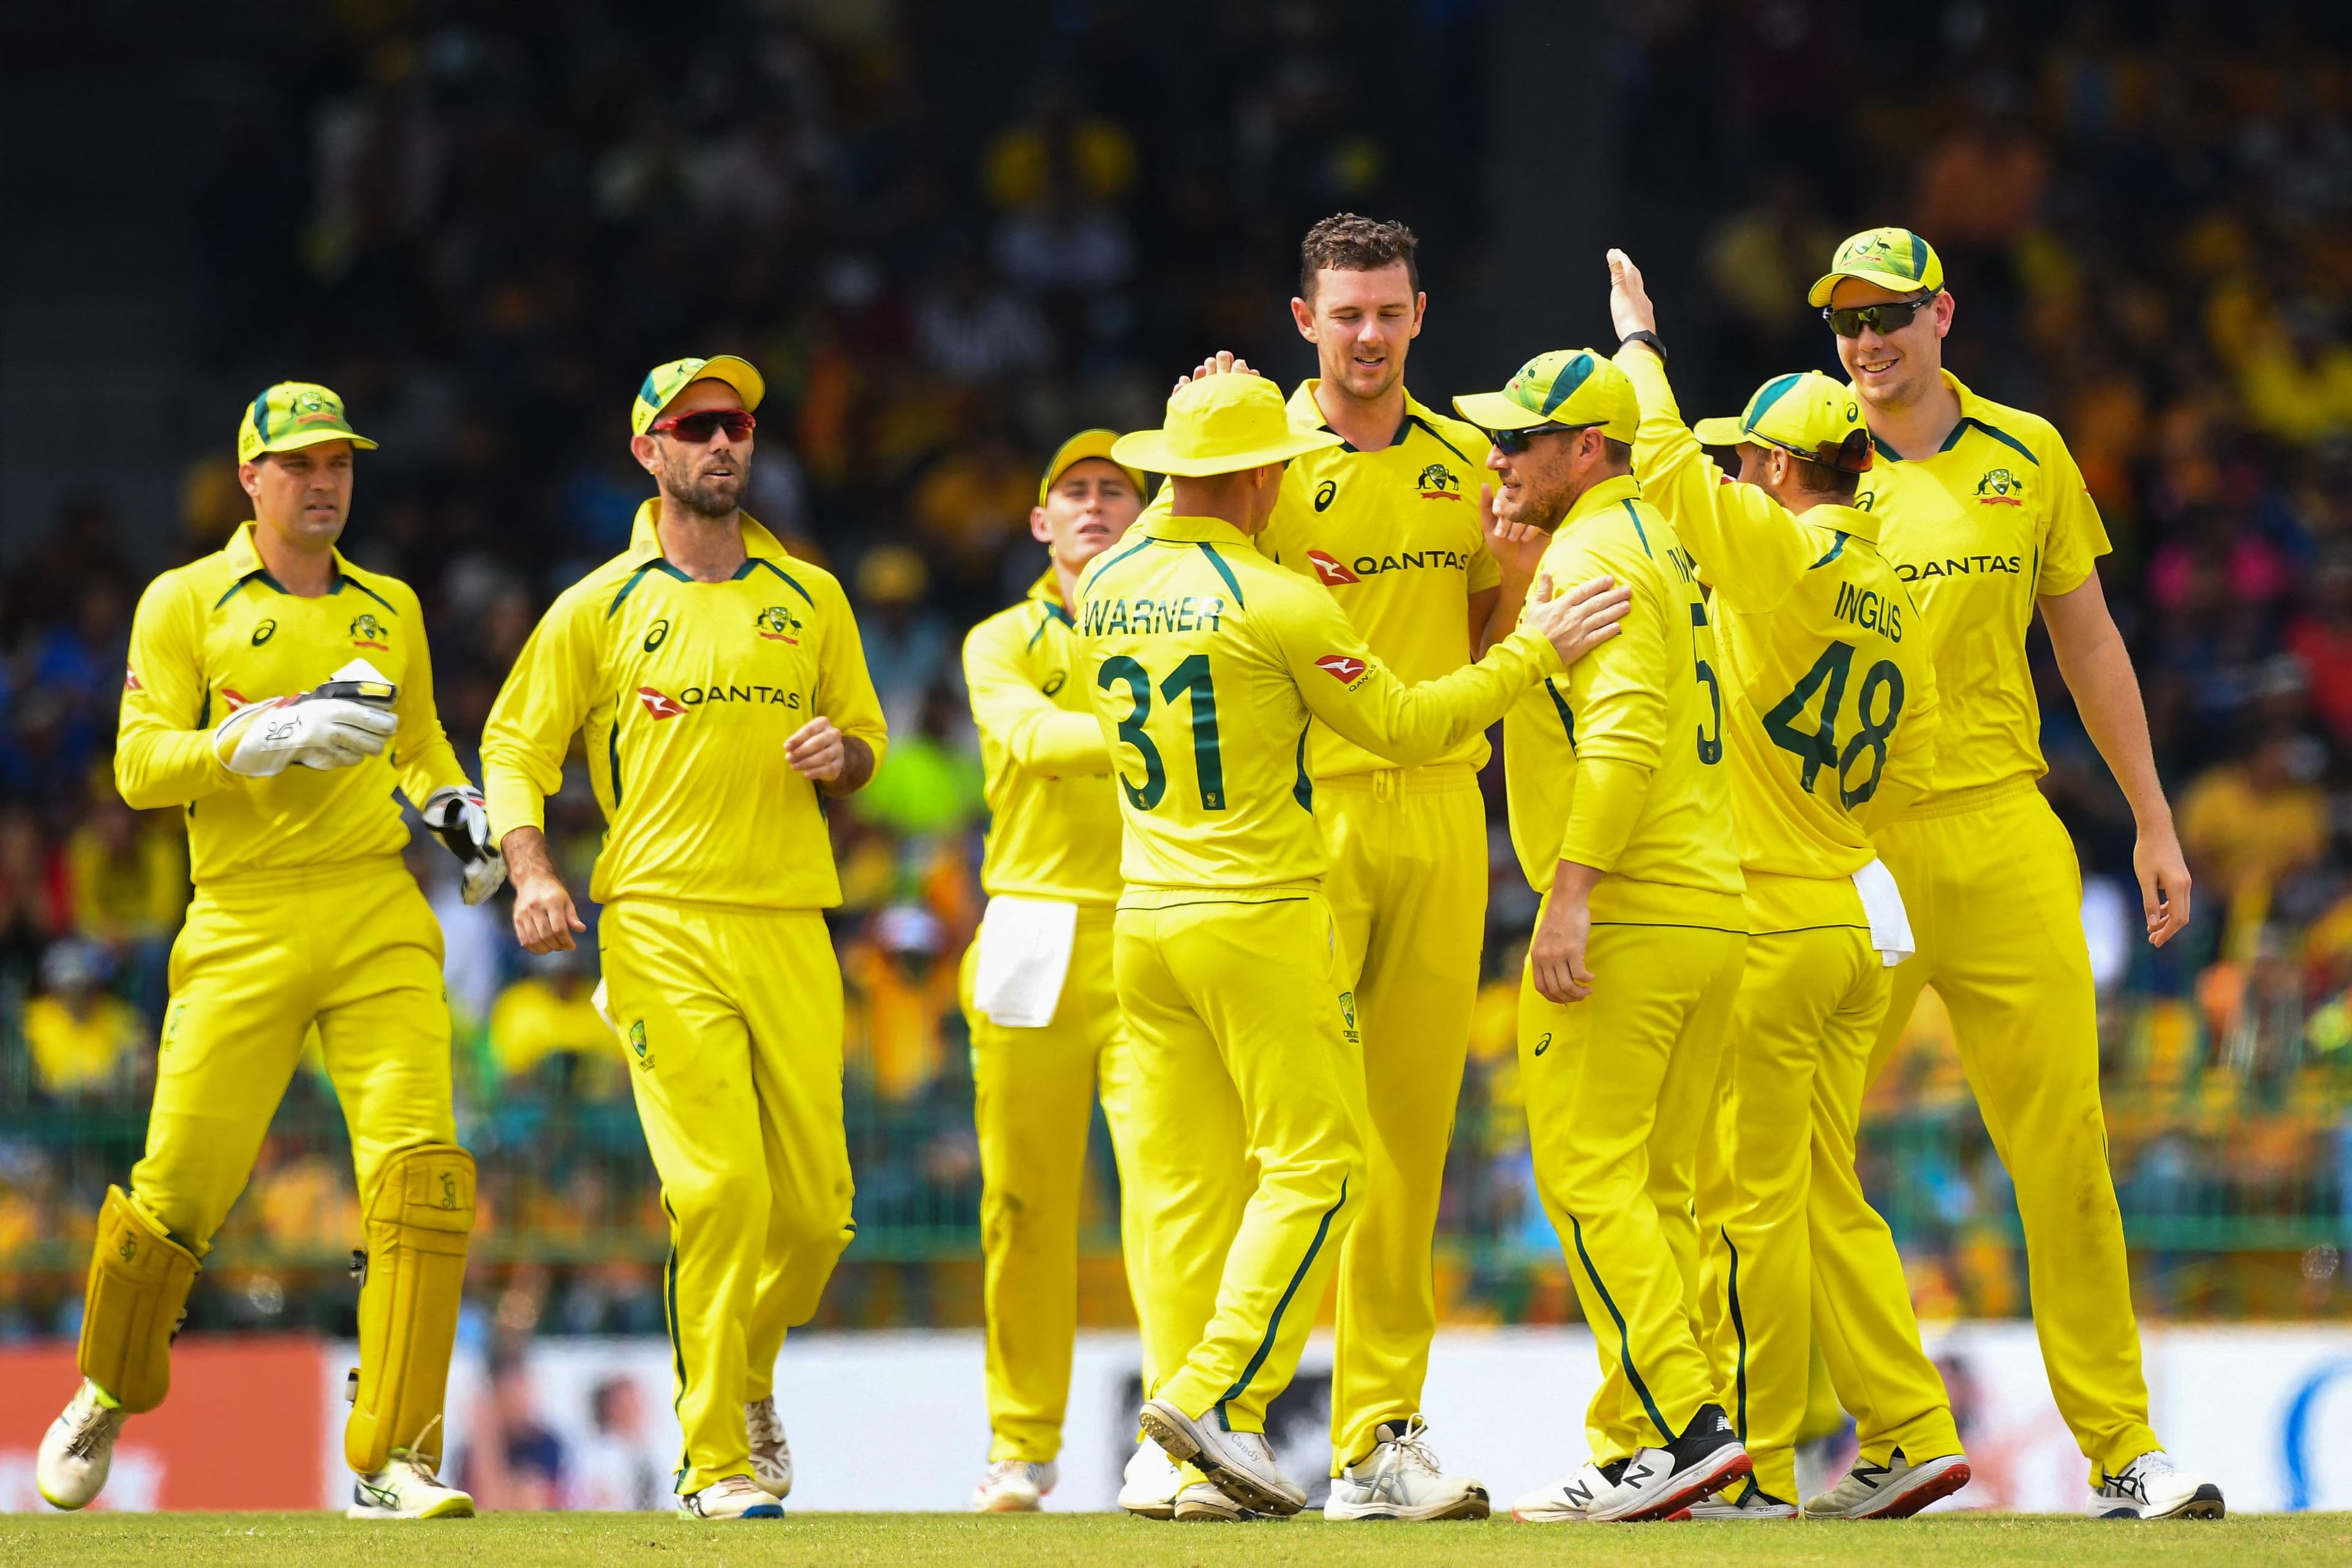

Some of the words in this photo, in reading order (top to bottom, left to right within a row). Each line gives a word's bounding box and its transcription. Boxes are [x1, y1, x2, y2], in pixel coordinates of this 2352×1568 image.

[1354, 551, 1468, 575] QANTAS
[1893, 555, 2021, 582] QANTAS
[1084, 597, 1224, 636] WARNER
[1834, 581, 1902, 643] INGLIS
[1349, 664, 1377, 692] QANAS
[1689, 602, 1723, 765] 5
[680, 685, 801, 710] QANTAS
[1097, 654, 1226, 811] 31
[1762, 639, 1905, 813] 48
[1232, 1434, 1259, 1461] Candy
